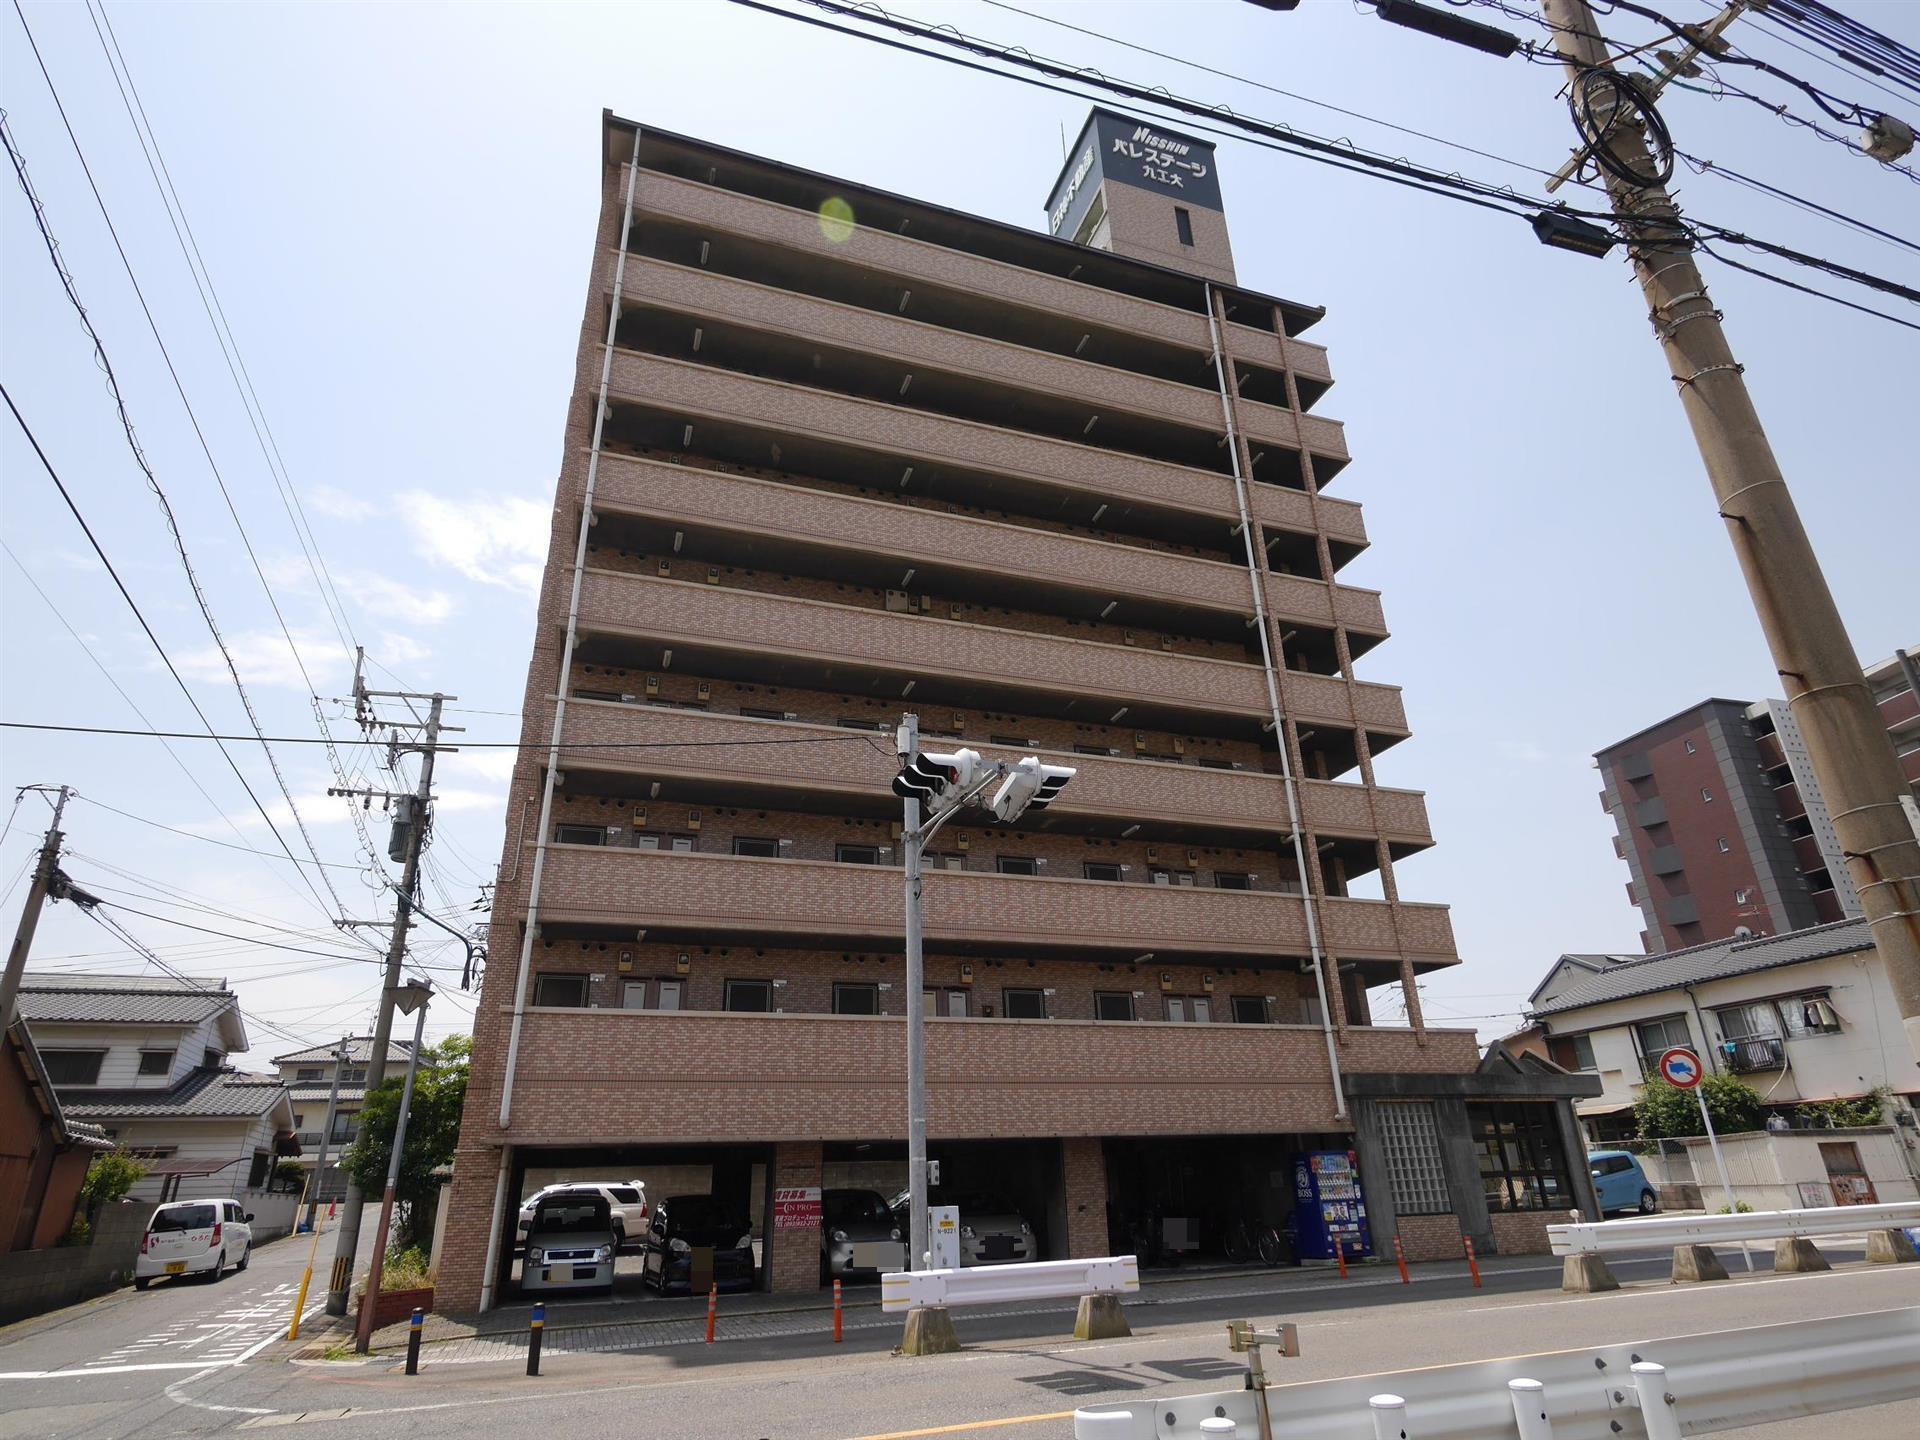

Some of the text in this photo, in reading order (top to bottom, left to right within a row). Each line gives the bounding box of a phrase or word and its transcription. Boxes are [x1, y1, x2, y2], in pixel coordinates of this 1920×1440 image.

[1112, 138, 1206, 178] パレステージ
[1142, 165, 1184, 188] 九工大
[1298, 1188, 1312, 1198] BOSS
